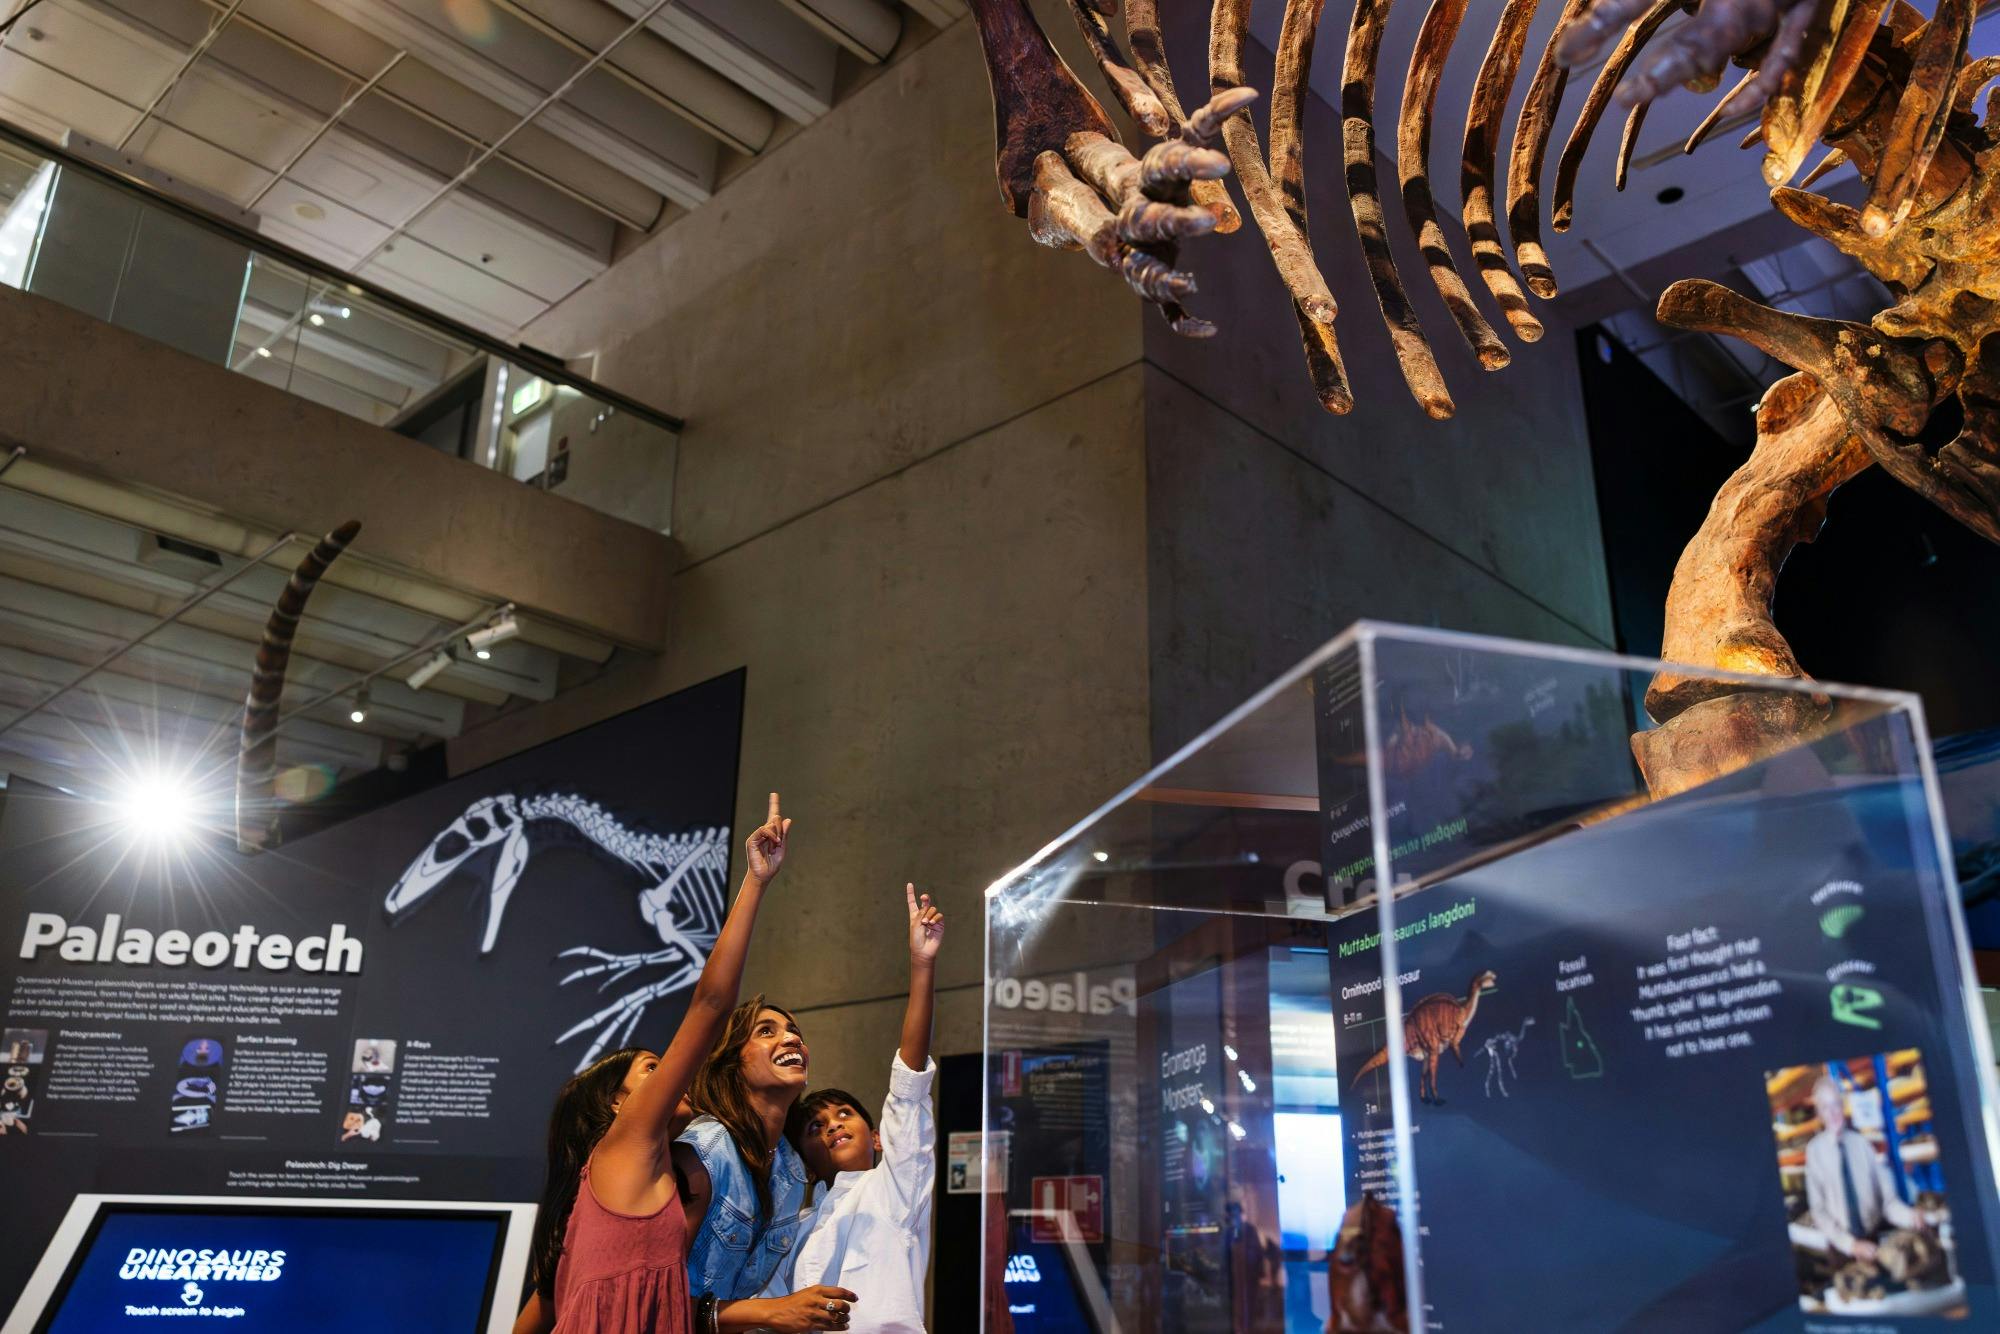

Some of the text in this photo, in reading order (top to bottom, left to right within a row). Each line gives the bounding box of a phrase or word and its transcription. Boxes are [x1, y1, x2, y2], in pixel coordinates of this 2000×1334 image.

[1428, 897, 1476, 931] langdoni
[19, 912, 363, 973] Palaeotech
[1667, 933, 1691, 951] Fast
[1647, 963, 1667, 977] was
[1667, 956, 1689, 972] first
[1690, 944, 1734, 966] thought
[1735, 937, 1760, 955] that
[1730, 960, 1754, 978] had
[1755, 960, 1766, 975] a
[1342, 976, 1382, 1000] Ornithopod
[1556, 973, 1594, 992] location
[1697, 992, 1716, 1008] like
[1654, 1024, 1674, 1038] has
[1674, 1019, 1701, 1035] since
[1702, 1012, 1730, 1030] been
[1733, 1005, 1773, 1024] shown
[236, 1034, 297, 1045] Surface Scanning
[1666, 1043, 1685, 1057] not
[1686, 1041, 1698, 1054] to
[1699, 1036, 1726, 1051] have
[1162, 1044, 1206, 1078] Eromanga
[328, 1162, 341, 1170] Dig
[342, 1162, 368, 1171] Deeper
[126, 1248, 286, 1267] DINOSAURS
[119, 1264, 282, 1281] UNEARTHED
[125, 1306, 245, 1318] Touch screen to begin
